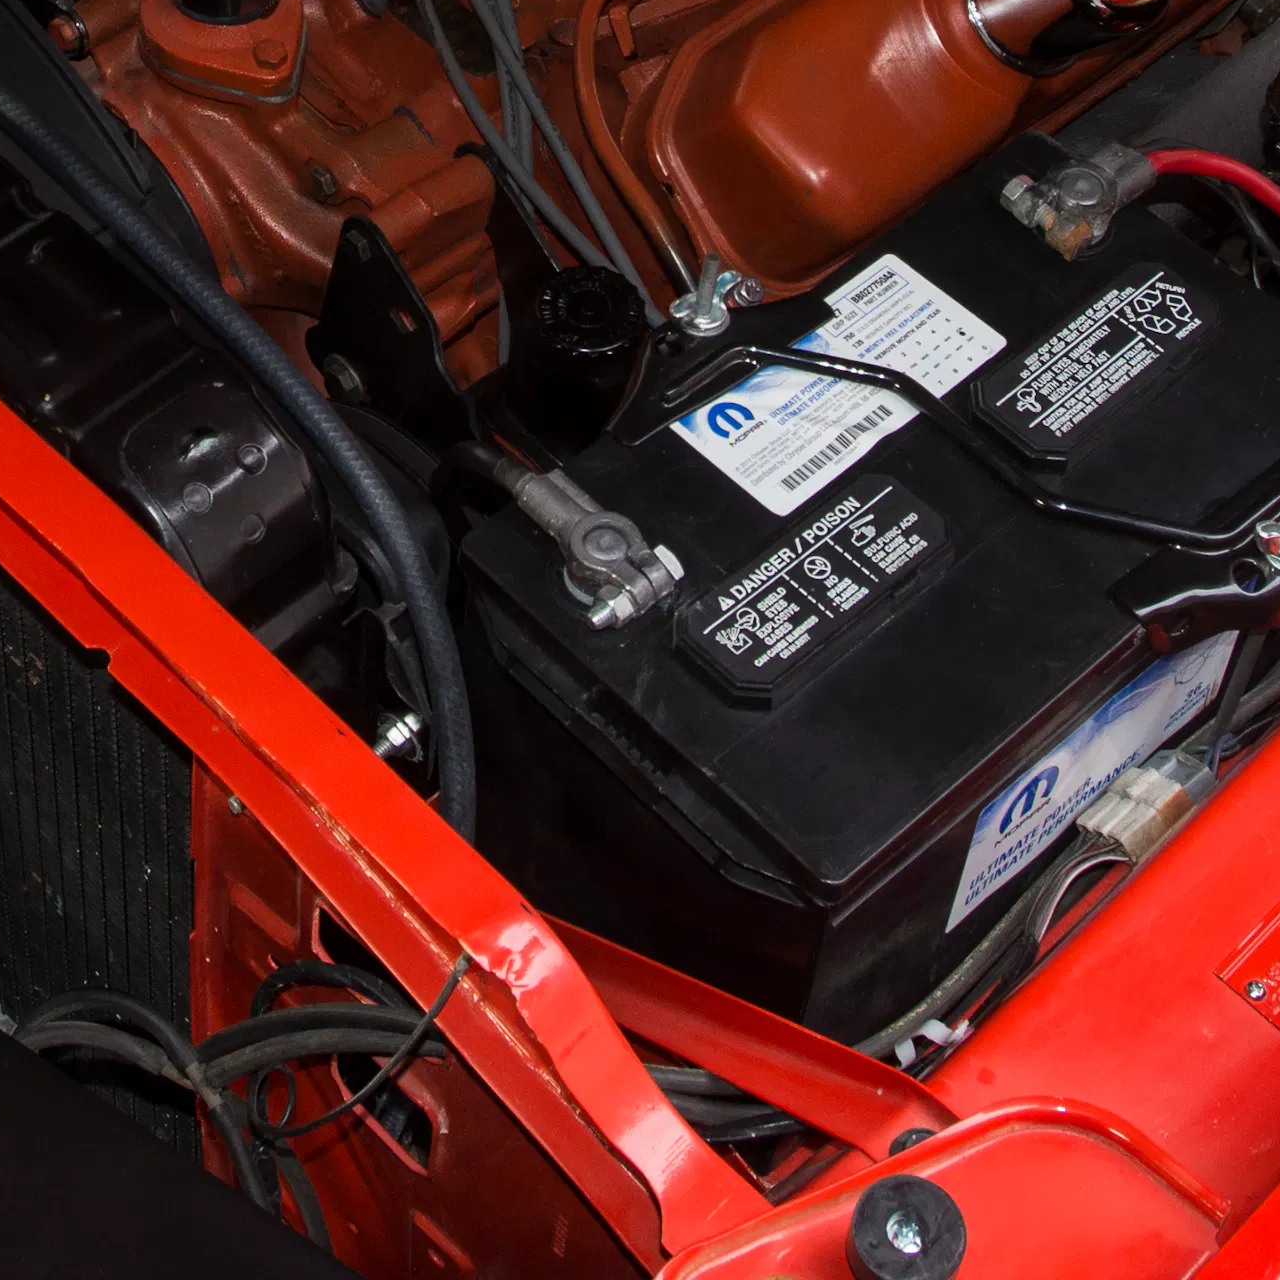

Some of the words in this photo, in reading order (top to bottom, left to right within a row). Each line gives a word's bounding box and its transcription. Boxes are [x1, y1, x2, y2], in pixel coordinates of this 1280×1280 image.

[849, 268, 896, 304] BB027750AA
[830, 317, 848, 331] GRP
[843, 309, 859, 321] SIZE
[862, 294, 879, 307] PART
[875, 278, 900, 298] NUMBER
[882, 327, 899, 339] FREE
[895, 298, 936, 329] REPLACEMENT
[842, 331, 857, 343] 750
[851, 338, 865, 349] 135
[872, 342, 898, 362] REMOVE
[894, 327, 917, 345] MONTH
[913, 319, 928, 330] AND
[925, 307, 942, 321] YEAR
[1018, 368, 1032, 379] DO
[1027, 359, 1043, 372] NOT
[1049, 339, 1068, 355] KEEP
[1062, 328, 1082, 344] VENT
[1076, 317, 1095, 333] CAPS
[1105, 296, 1122, 310] AND
[1116, 285, 1136, 301] LEVEL
[1022, 351, 1041, 366] KEEP
[1036, 342, 1053, 355] OUT
[1047, 335, 1061, 346] OF
[1055, 327, 1072, 340] THE
[1066, 313, 1089, 331] REACH
[1083, 307, 1097, 318] OF
[1091, 288, 1121, 312] CHILDREN
[1174, 317, 1203, 340] RECYCLE
[1029, 369, 1056, 390] FLUSH
[1049, 355, 1073, 374] EYES
[1066, 323, 1113, 361] IMMEDIATELY
[1037, 378, 1060, 397] WITH
[1077, 348, 1097, 364] GET
[1045, 376, 1079, 403] MEDICAL
[1073, 362, 1096, 381] HELP
[1089, 349, 1112, 368] FAST
[1062, 396, 1078, 409] FOR
[1122, 341, 1147, 361] FOLLOW
[768, 393, 803, 420] ULTIMATE
[776, 399, 810, 426] ULTIMATE
[728, 419, 765, 448] MOPAR
[783, 441, 808, 461] Chrysler
[728, 546, 797, 600] DANGER
[787, 536, 809, 554] /
[800, 494, 862, 544] POISON
[861, 524, 903, 558] SULFURIC
[896, 510, 921, 530] ACID
[869, 548, 888, 564] CAN
[882, 533, 907, 553] CAUSE
[906, 533, 921, 545] OR
[822, 573, 841, 588] NO
[825, 576, 853, 599] SPARKS
[754, 585, 789, 613] SHIELD
[762, 597, 790, 619] EYES
[754, 602, 801, 639] EXPLOSIVE
[762, 620, 795, 646] GASES
[752, 652, 771, 668] CAN
[764, 637, 790, 658] CAUSE
[970, 822, 1040, 889] ULTIMATE
[964, 844, 1034, 906] ULTIMATE
